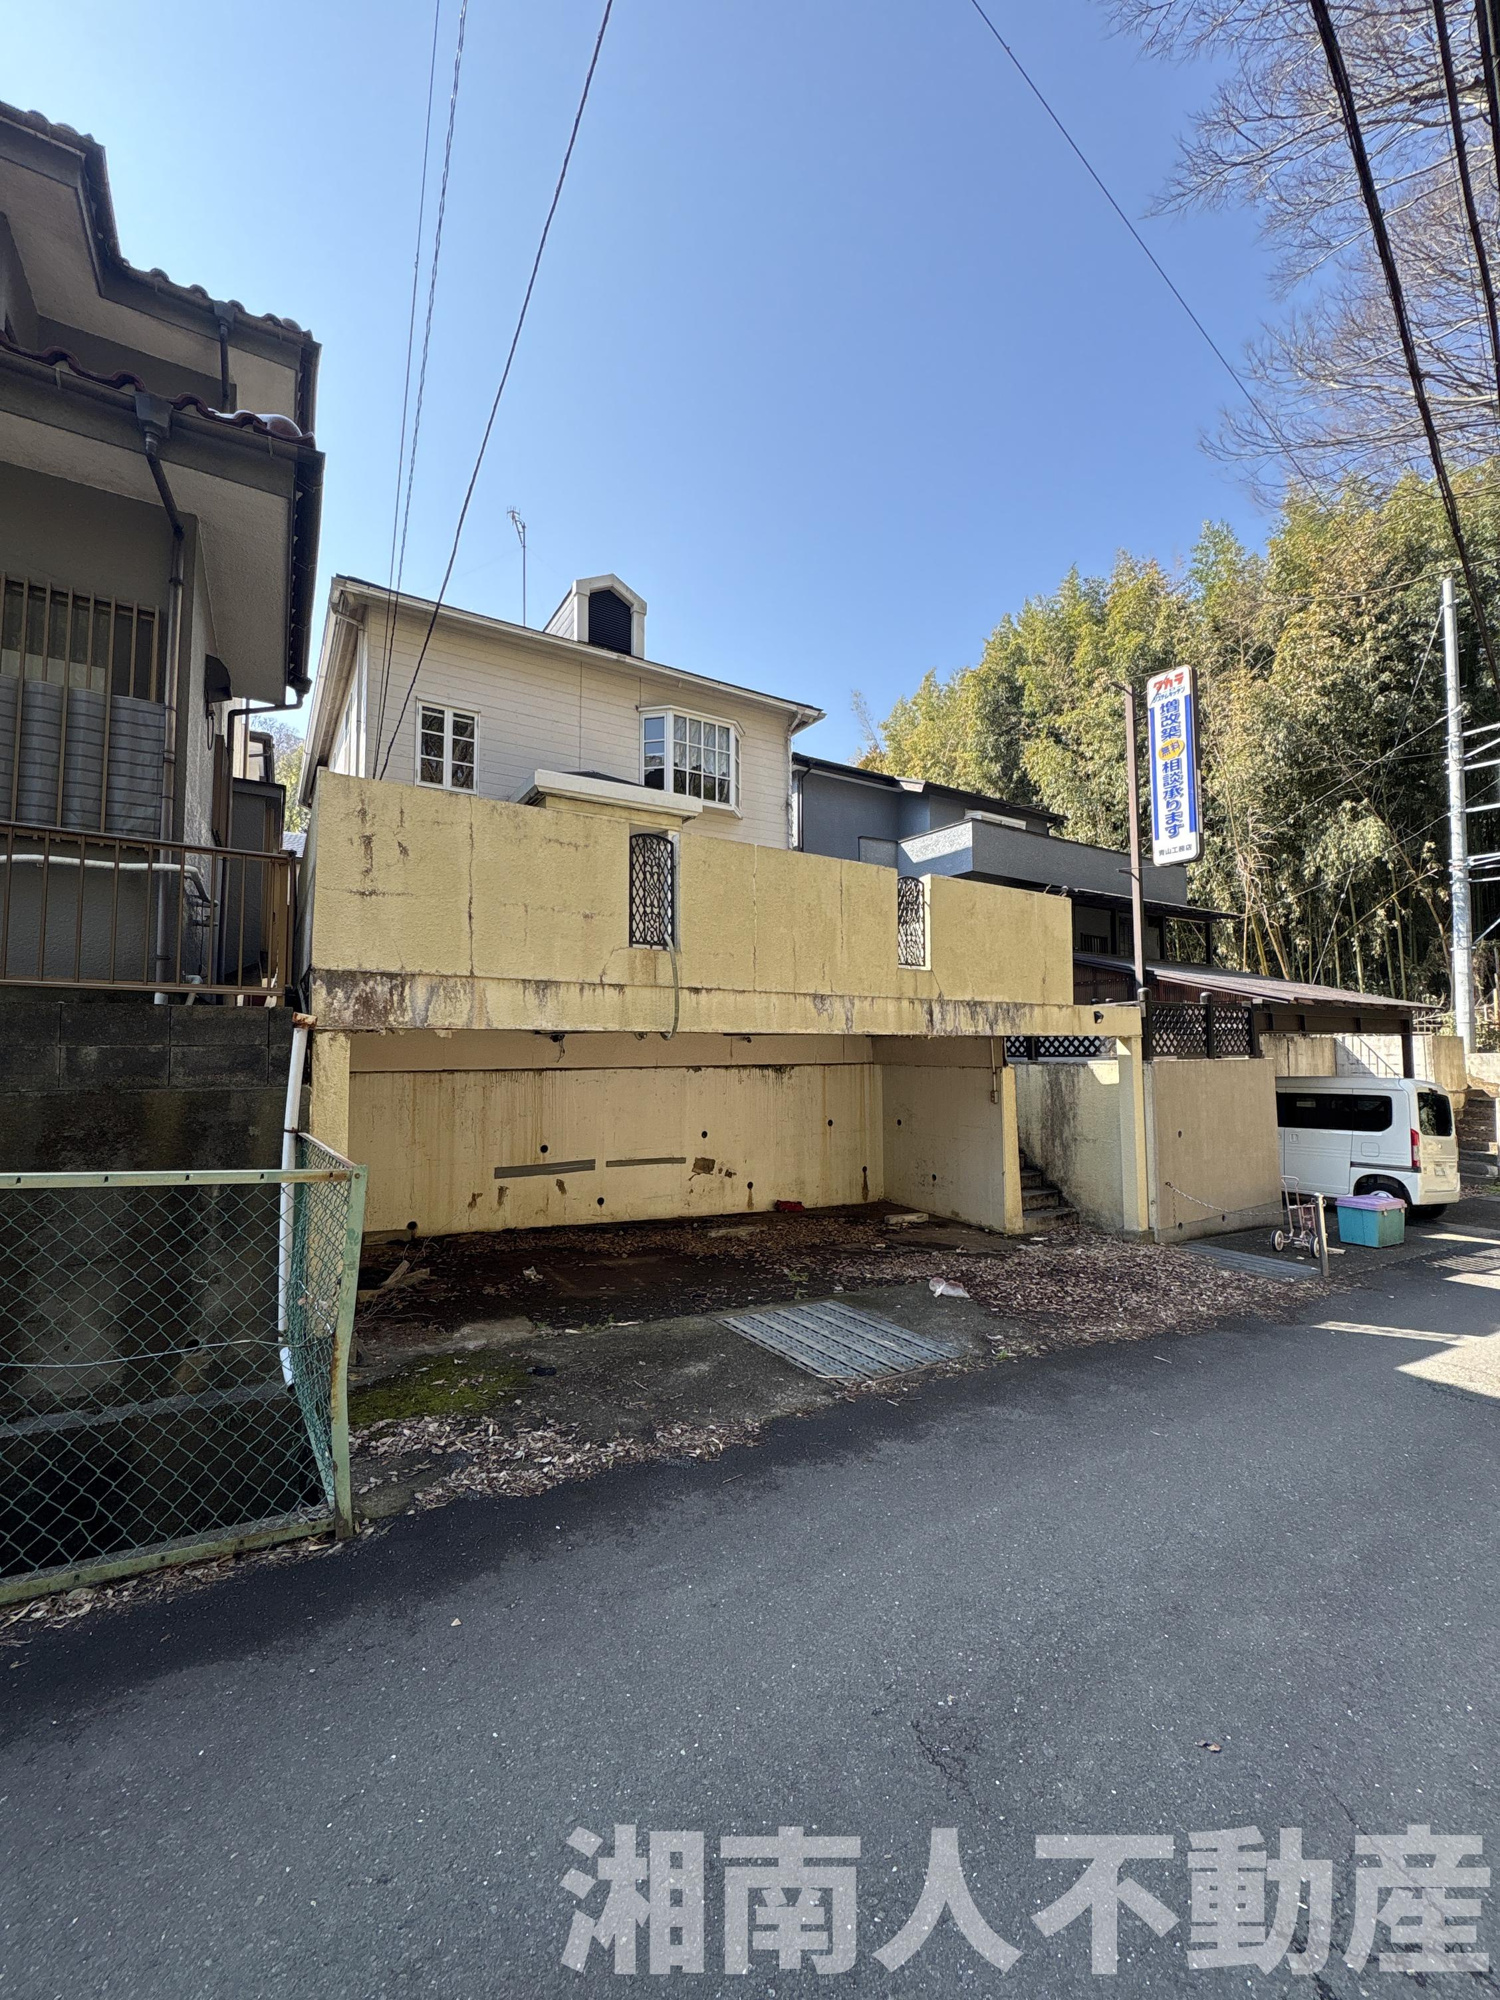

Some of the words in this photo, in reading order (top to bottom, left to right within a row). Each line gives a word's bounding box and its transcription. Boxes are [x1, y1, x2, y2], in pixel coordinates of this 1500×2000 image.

[1152, 672, 1184, 696] タカラ
[1159, 698, 1182, 741] 増改築
[1160, 740, 1181, 758] 無料
[1162, 757, 1184, 839] 相談承ります
